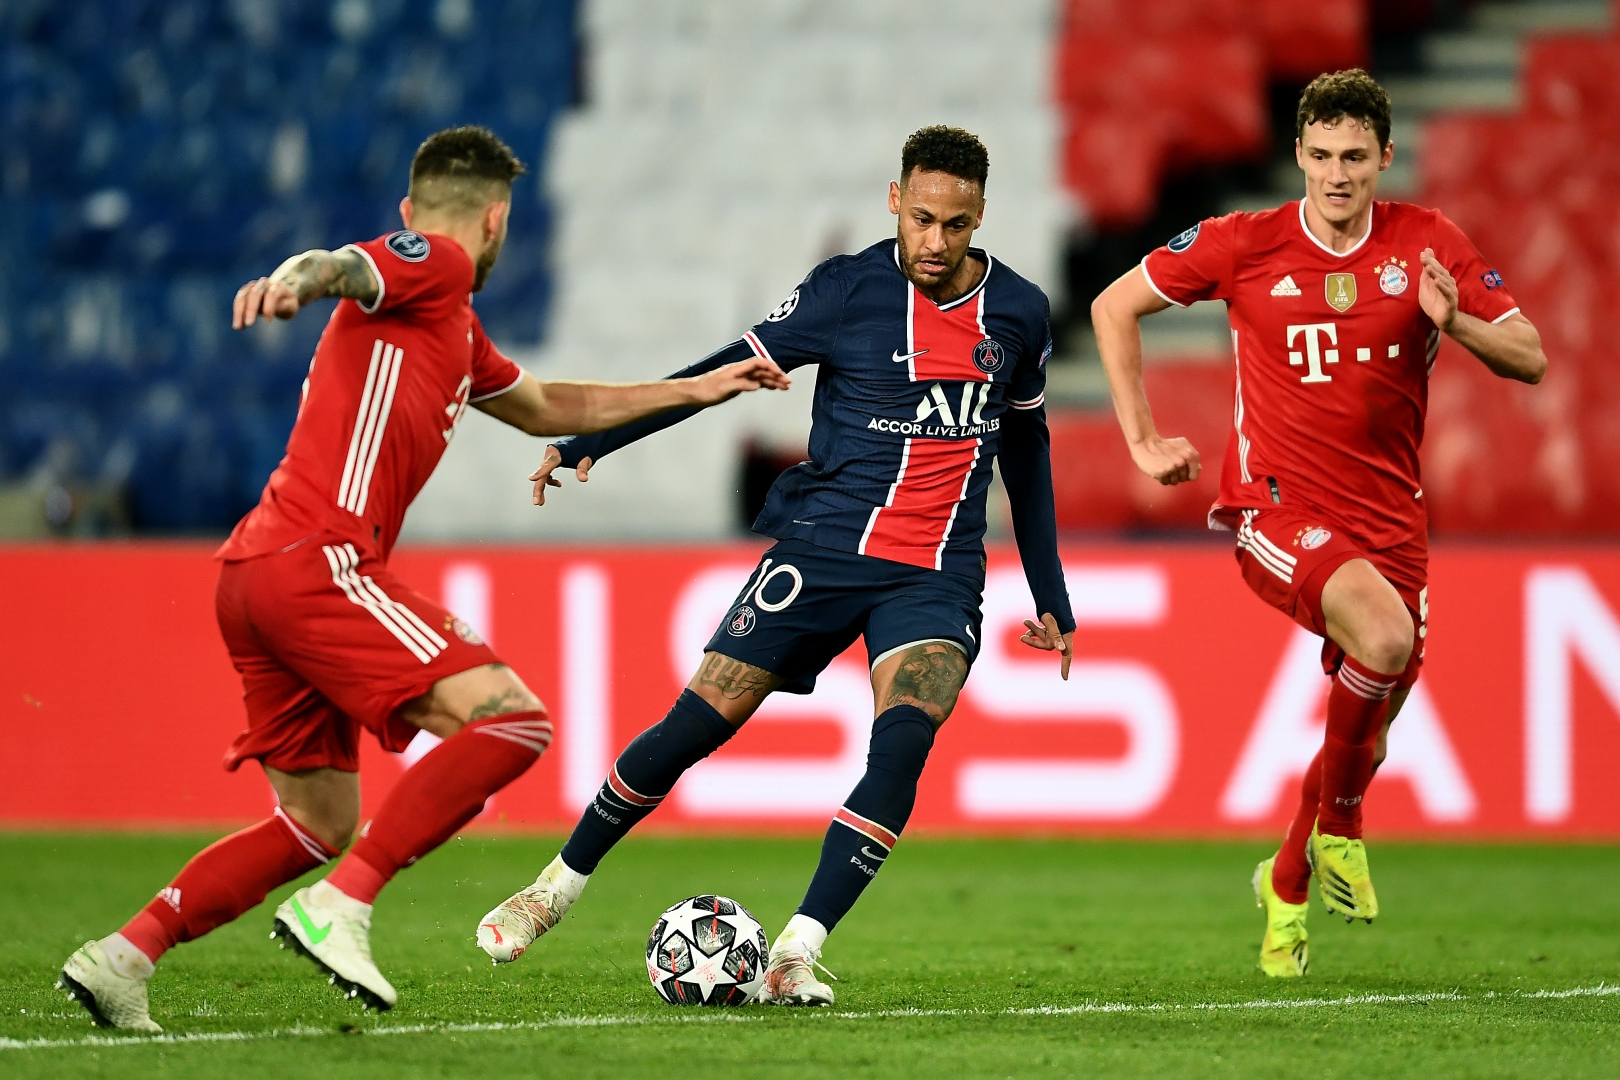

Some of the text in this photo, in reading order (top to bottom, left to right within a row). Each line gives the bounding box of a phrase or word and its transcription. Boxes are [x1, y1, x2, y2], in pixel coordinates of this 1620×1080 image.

[979, 341, 1000, 351] PARIS
[867, 417, 922, 435] ACCOR
[925, 425, 959, 437] LIVE
[741, 558, 803, 612] 10
[738, 606, 754, 619] PARIS
[1335, 795, 1362, 806] FCB
[593, 796, 621, 825] PARIS
